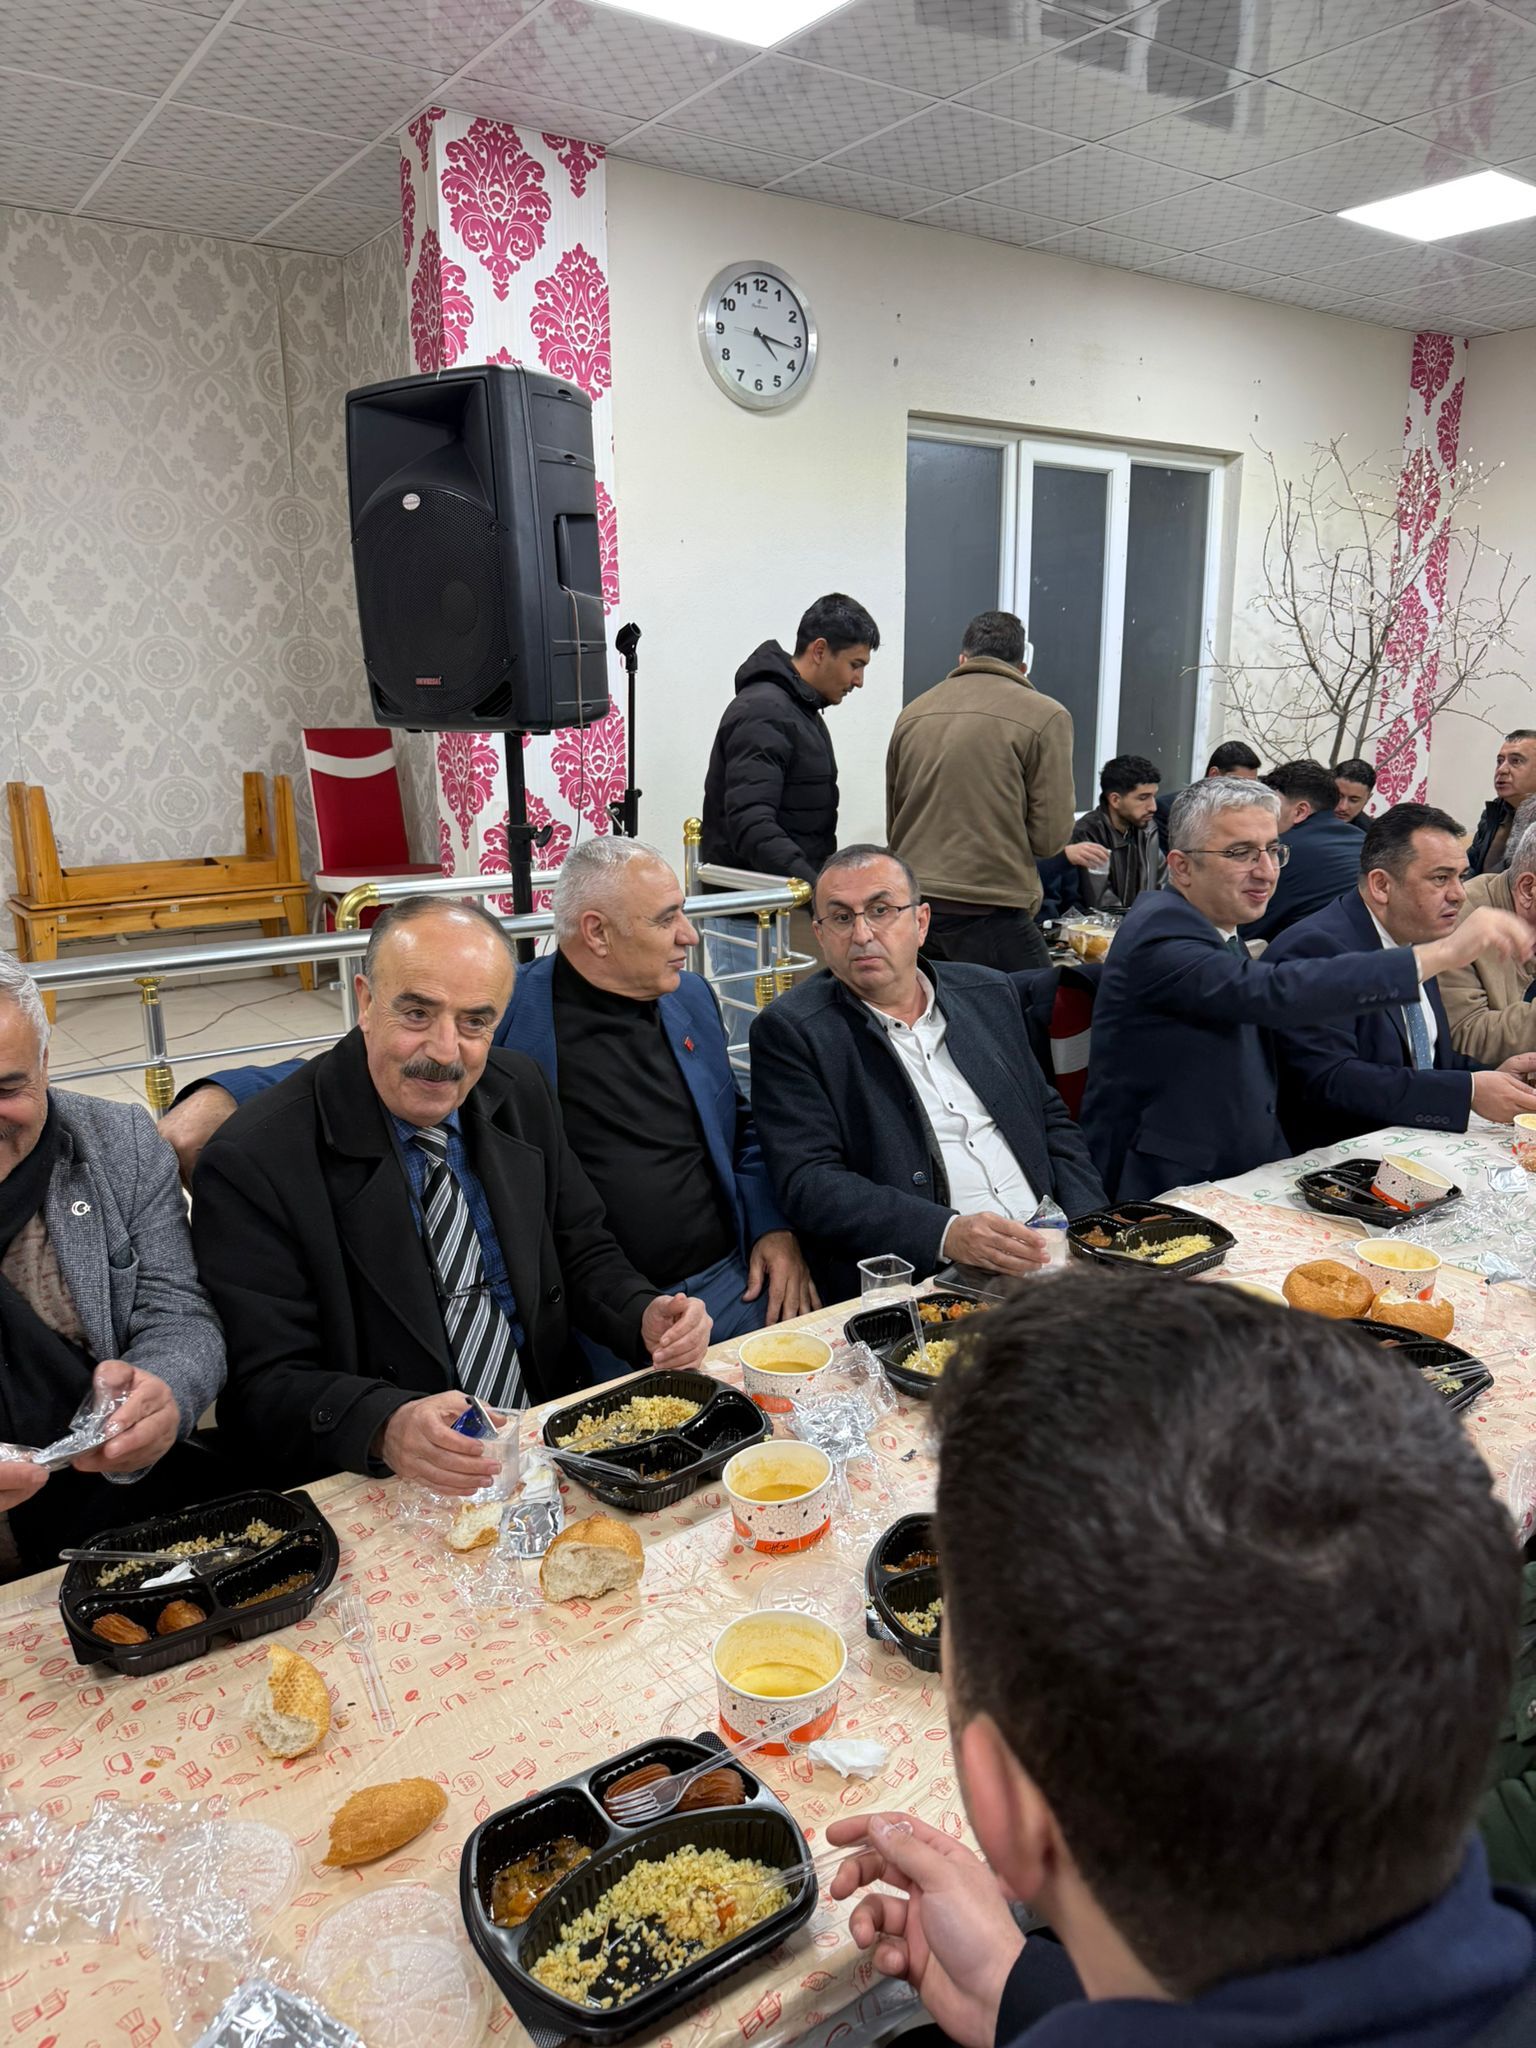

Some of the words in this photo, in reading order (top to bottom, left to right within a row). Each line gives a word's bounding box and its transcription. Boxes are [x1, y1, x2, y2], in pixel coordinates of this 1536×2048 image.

[734, 281, 748, 296] 11
[753, 278, 768, 293] 12
[775, 289, 782, 302] 1
[720, 297, 736, 312] 10
[788, 310, 797, 323] 2
[716, 322, 725, 335] 9
[793, 336, 802, 349] 3
[721, 348, 730, 361] 8
[787, 359, 796, 372] 4
[736, 369, 745, 382] 7
[773, 375, 782, 388] 5
[754, 379, 763, 391] 6
